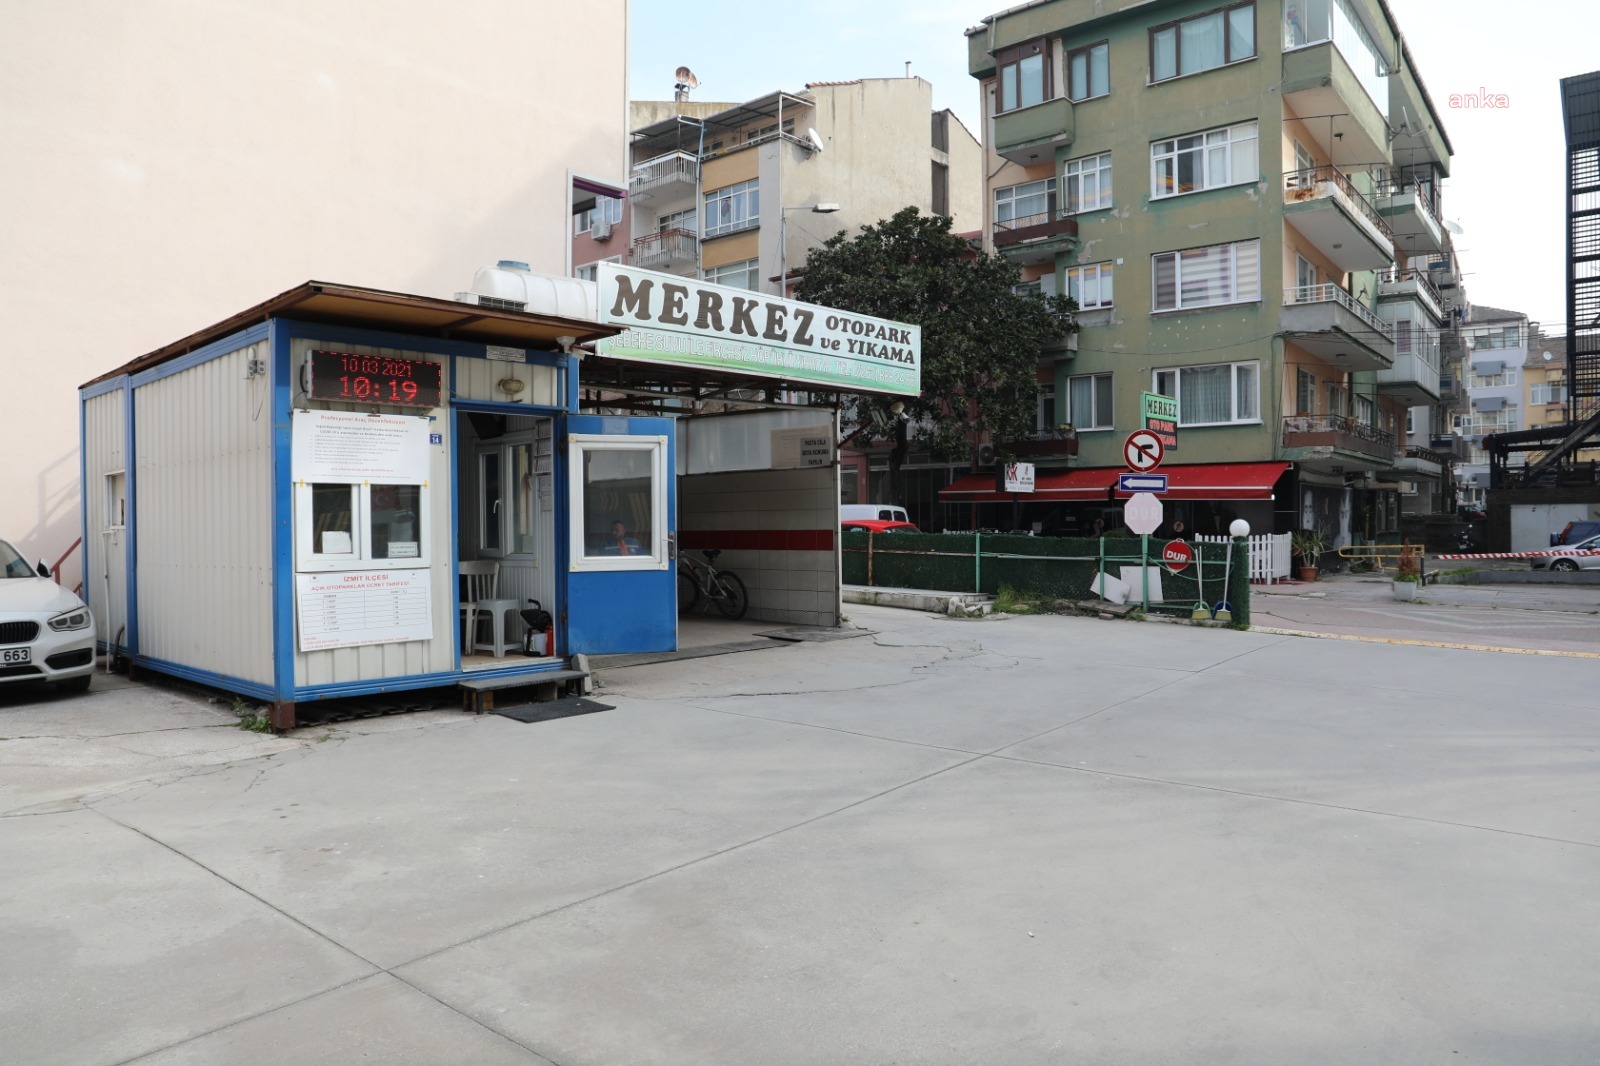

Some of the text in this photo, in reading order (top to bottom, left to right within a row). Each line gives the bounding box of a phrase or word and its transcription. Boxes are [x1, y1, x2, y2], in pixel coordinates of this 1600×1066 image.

[610, 274, 815, 346] MERKEZ
[826, 315, 911, 345] OTOPARK
[608, 329, 654, 351] ŞEBEKE
[655, 334, 687, 354] SUYU
[687, 335, 704, 356] İLE
[704, 340, 750, 364] FIRÇASIZ
[751, 346, 795, 368] KÖPÜKLÜ
[796, 354, 831, 374] YIKAMA
[820, 336, 915, 364] ve YIKAMA
[382, 362, 412, 377] 2021
[339, 376, 418, 401] 10:19
[1147, 399, 1177, 417] MERKEZ
[320, 414, 353, 423] Profesyonel
[431, 436, 439, 444] 14
[1129, 507, 1159, 521] DUR
[1166, 550, 1187, 562] DUR
[343, 573, 389, 583] İZMİT İLÇESİ
[4, 649, 28, 662] 663
